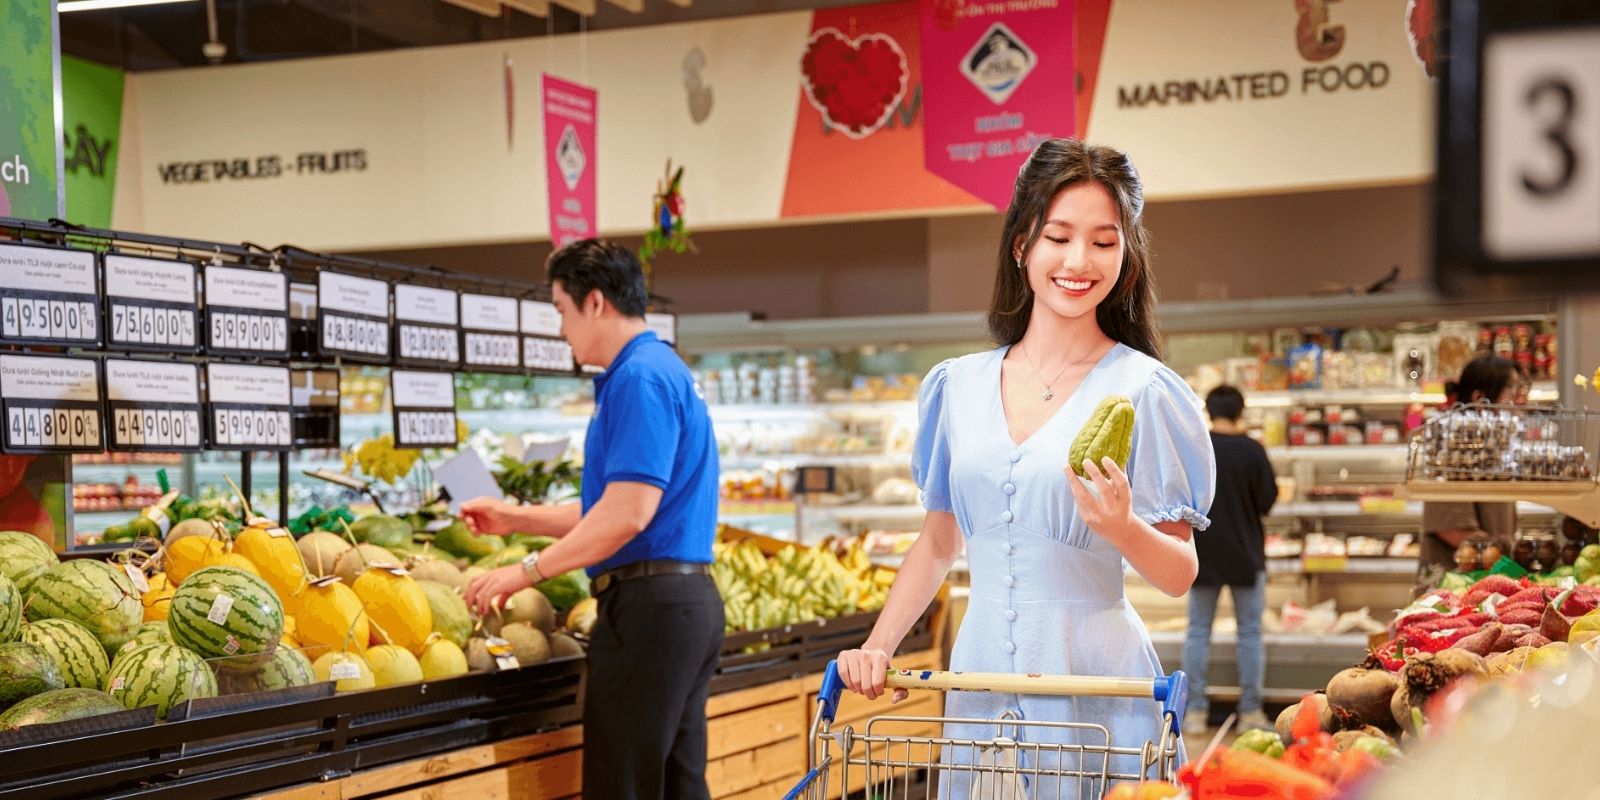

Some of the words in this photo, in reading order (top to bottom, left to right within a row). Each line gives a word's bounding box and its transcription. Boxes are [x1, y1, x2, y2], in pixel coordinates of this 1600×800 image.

[1117, 71, 1289, 108] MARINATED
[1303, 61, 1390, 94] FOOD
[1521, 76, 1577, 197] 3
[158, 156, 282, 185] VEGETABLES
[297, 148, 367, 176] FRUITS
[6, 304, 77, 330] 49.500
[115, 311, 179, 336] 75.600
[215, 319, 271, 342] 59.900
[12, 413, 83, 438] 44.800
[118, 413, 182, 438] 44.900
[219, 414, 276, 437] 59.900
